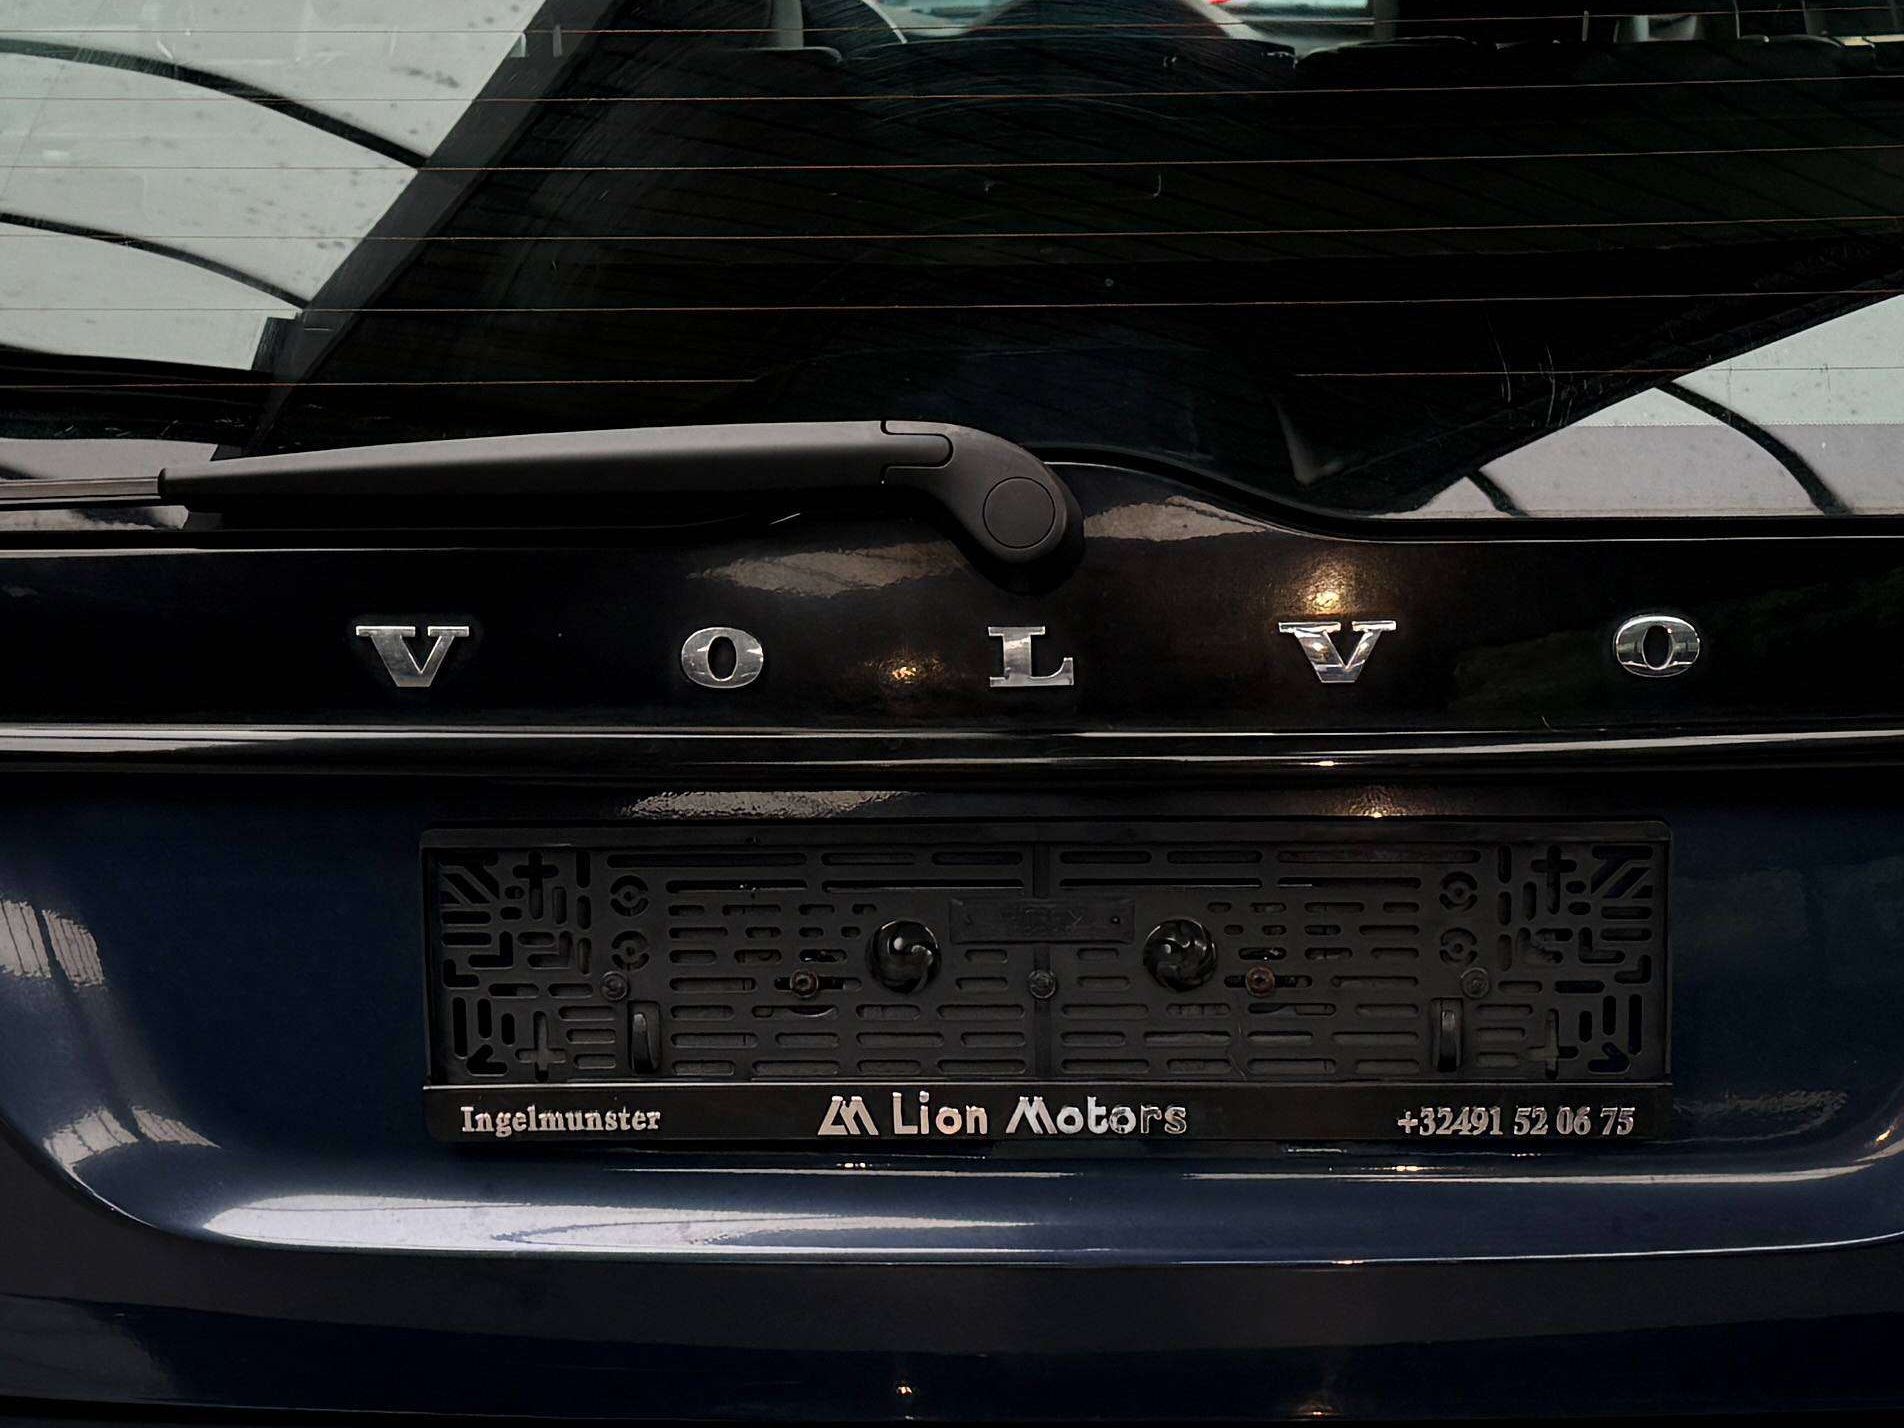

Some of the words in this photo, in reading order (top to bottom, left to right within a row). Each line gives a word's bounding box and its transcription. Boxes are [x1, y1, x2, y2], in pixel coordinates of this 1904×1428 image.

[354, 614, 1701, 691] VOLVO
[460, 1104, 661, 1138] Ingelmunster
[892, 1091, 988, 1135] Lion
[1005, 1095, 1187, 1135] Motors
[1397, 1106, 1504, 1137] +32491
[1513, 1106, 1549, 1136] 52
[1556, 1106, 1592, 1136] 06
[1600, 1106, 1636, 1136] 75
